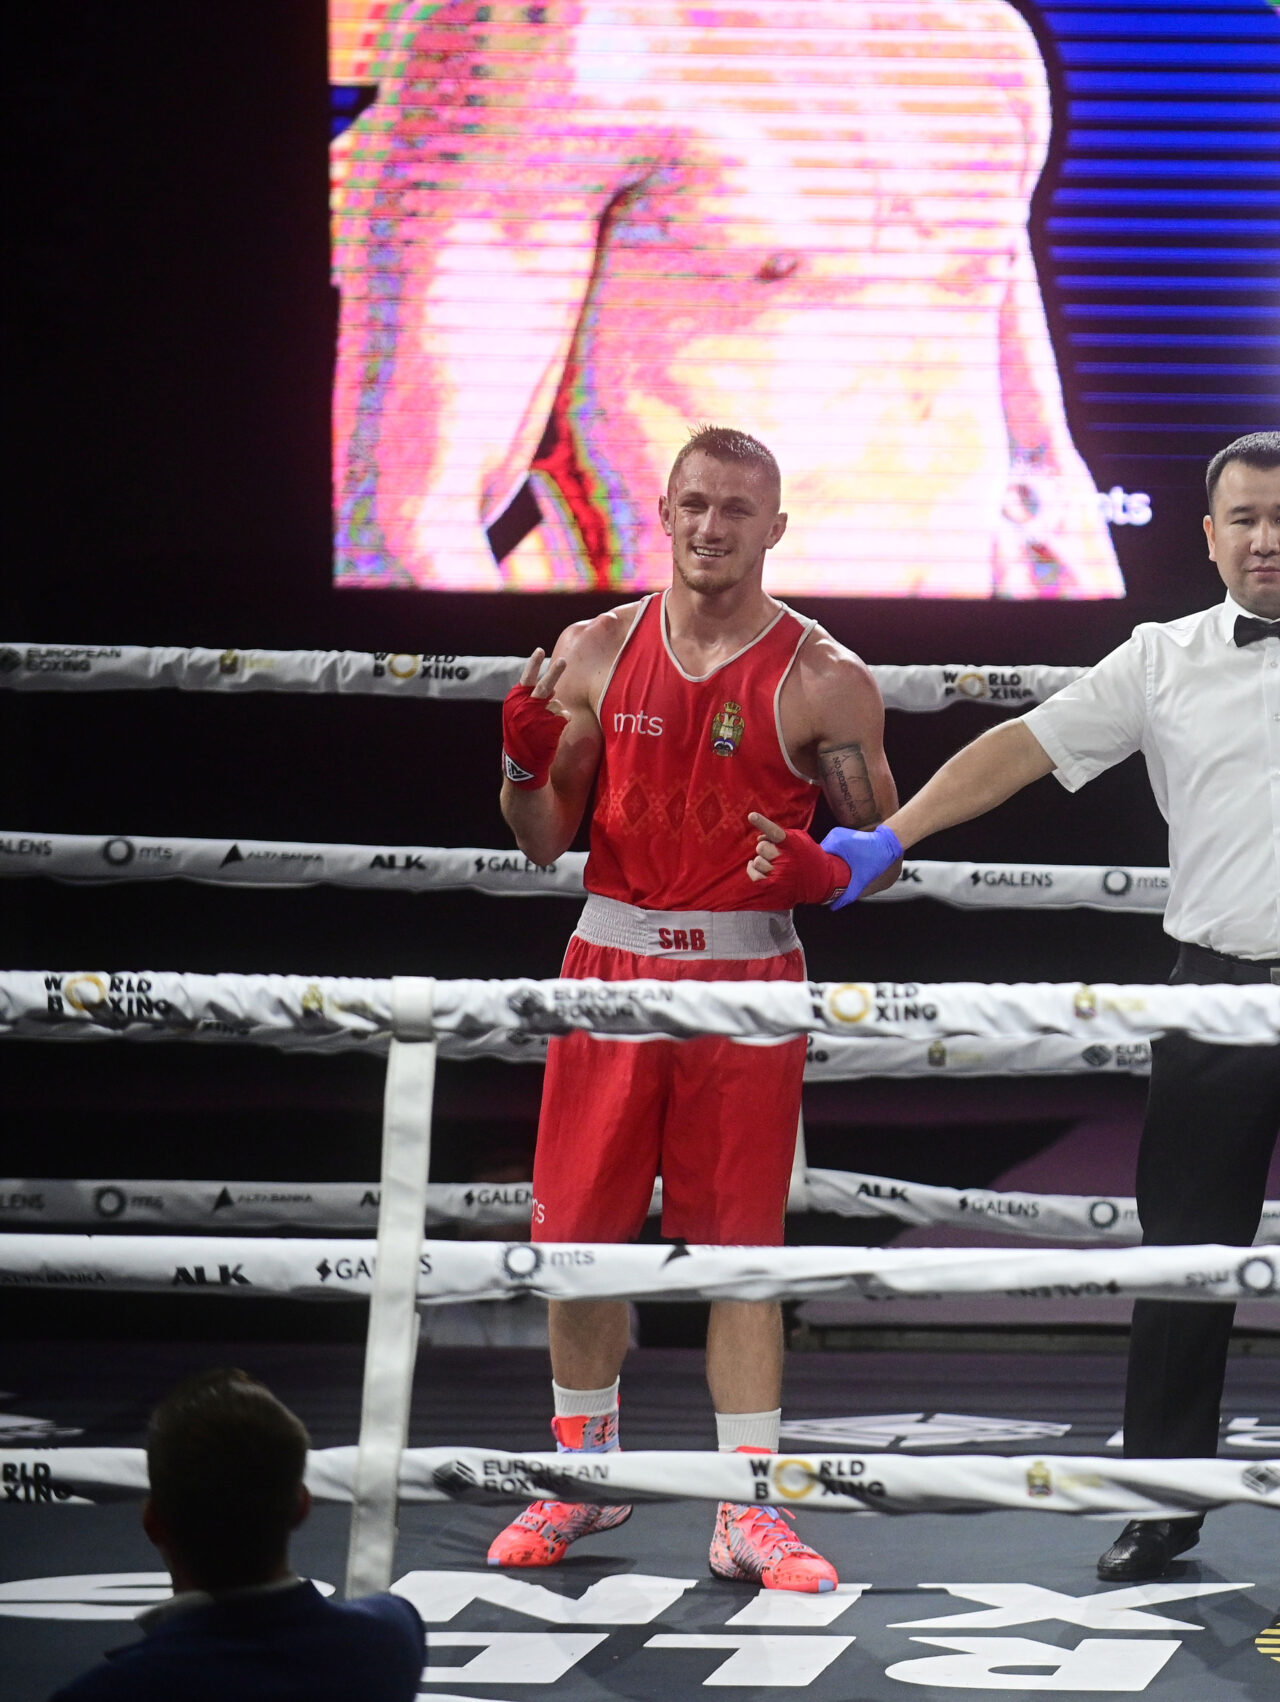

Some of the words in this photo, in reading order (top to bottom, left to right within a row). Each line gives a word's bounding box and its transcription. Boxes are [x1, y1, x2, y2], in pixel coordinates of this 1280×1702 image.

[26, 646, 122, 660] EUROPEAN
[613, 709, 664, 738] mts
[0, 838, 52, 857] ALENS
[369, 853, 426, 871] ALK
[984, 871, 1054, 888] GALENS
[1136, 875, 1169, 889] mts
[658, 927, 707, 951] SRB
[857, 1182, 910, 1201] ALK
[172, 1263, 252, 1286] ALK
[550, 1247, 595, 1267] mts
